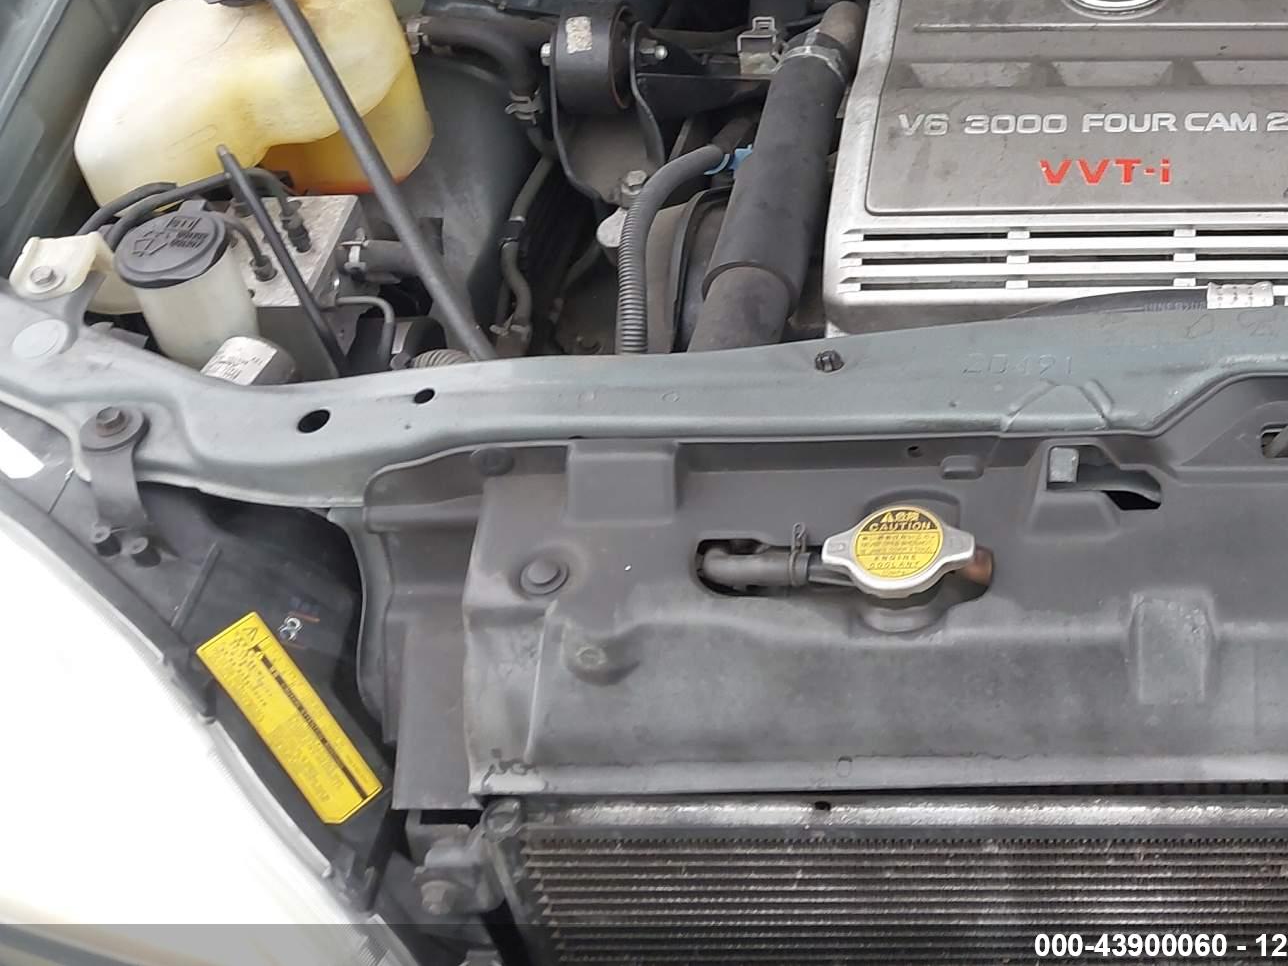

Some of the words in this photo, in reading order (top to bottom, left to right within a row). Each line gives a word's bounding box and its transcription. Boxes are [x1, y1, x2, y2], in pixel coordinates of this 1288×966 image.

[898, 113, 949, 135] V6
[964, 113, 1069, 135] 3000
[1081, 112, 1178, 134] FOUR
[1184, 112, 1258, 133] CAM
[1039, 158, 1172, 186] VVT-i
[868, 521, 931, 531] CAUTION
